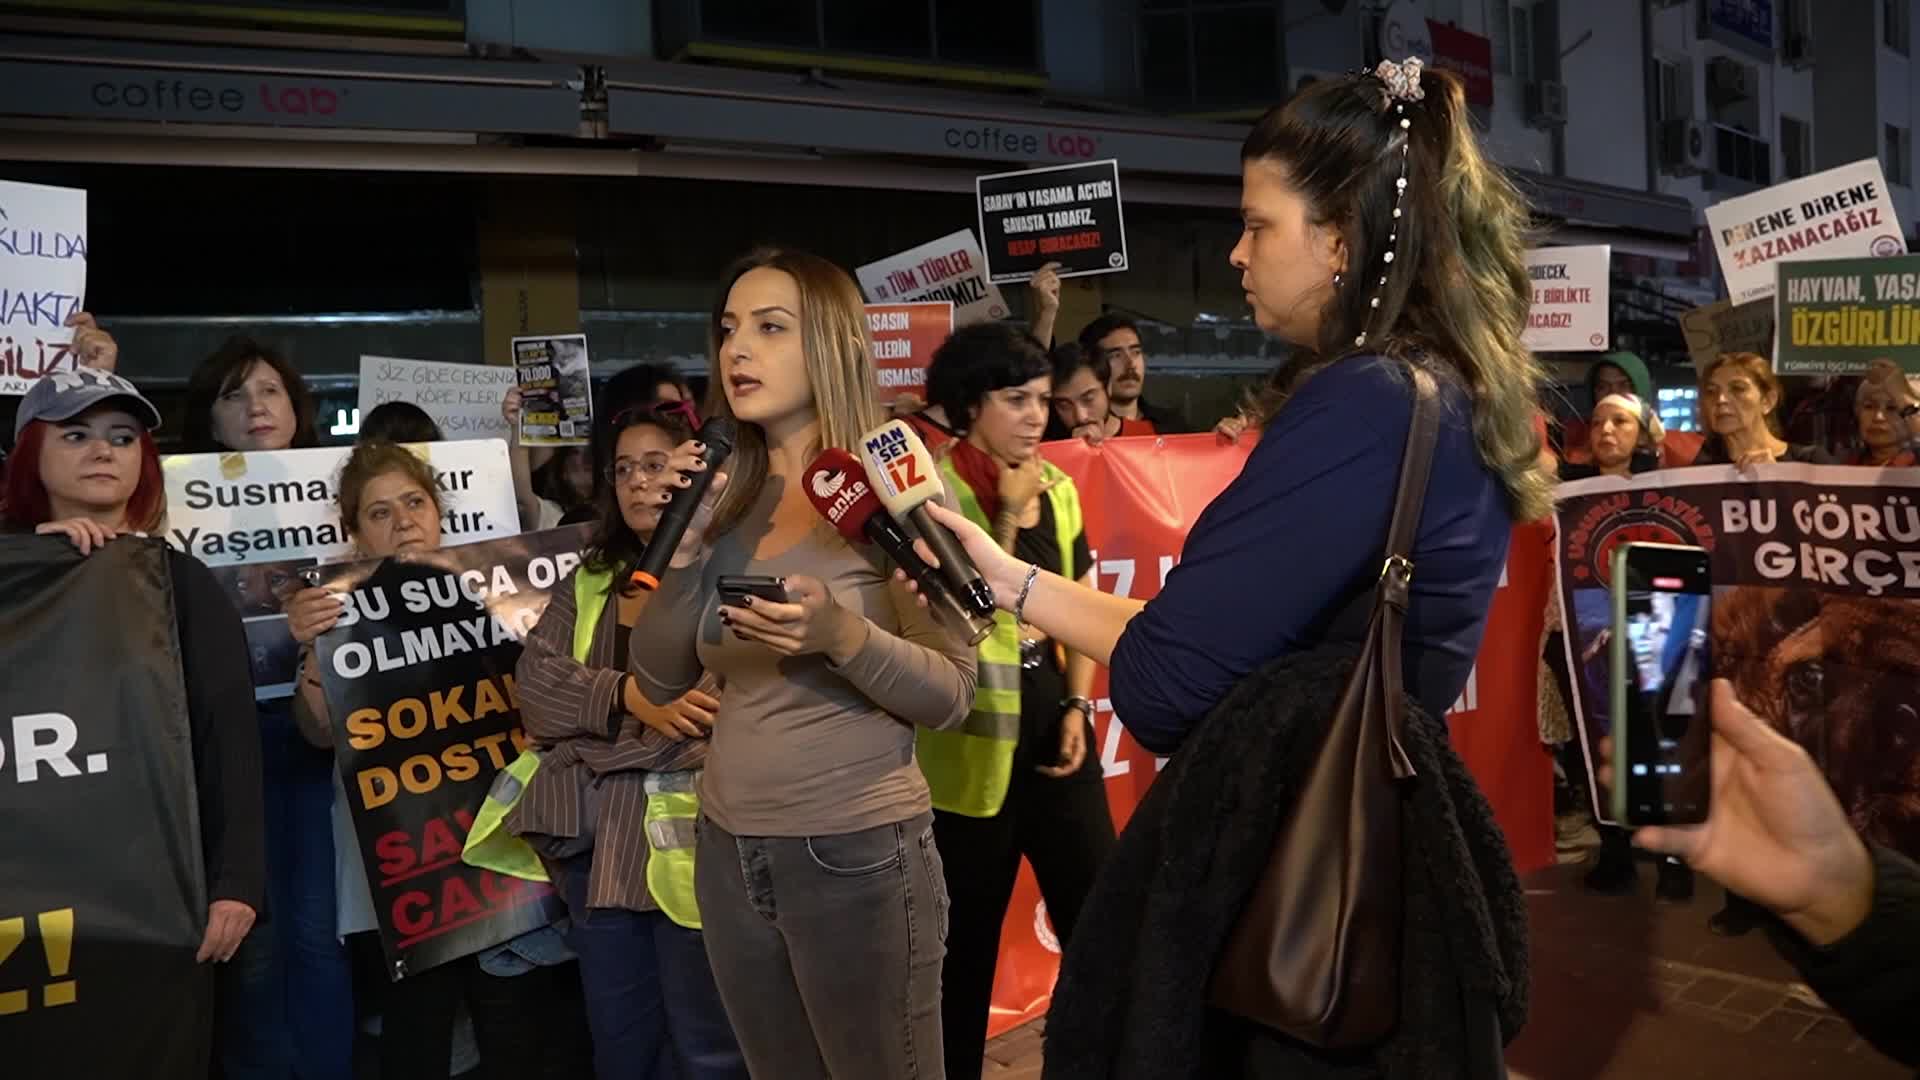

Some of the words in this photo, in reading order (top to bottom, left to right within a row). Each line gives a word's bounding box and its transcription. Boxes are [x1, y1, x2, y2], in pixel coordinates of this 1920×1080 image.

[90, 79, 244, 113] coffee
[257, 82, 338, 115] lab
[944, 126, 1039, 154] coffee
[1046, 132, 1097, 158] lab
[1801, 182, 1879, 221] DİRENE
[1733, 208, 1883, 270] KAZANACAĞIZ
[885, 269, 919, 296] TÜM
[917, 249, 973, 285] TÜRLER
[1787, 276, 1866, 304] HAYVAN,
[1874, 273, 1920, 301] YAŞ
[865, 426, 905, 454] MAN
[879, 440, 909, 463] SET
[827, 481, 866, 520] anka
[1721, 499, 1777, 534] BU
[440, 509, 494, 535] tır.
[334, 586, 391, 629] BU
[400, 565, 519, 613] SUÇA
[0, 712, 109, 784] R.
